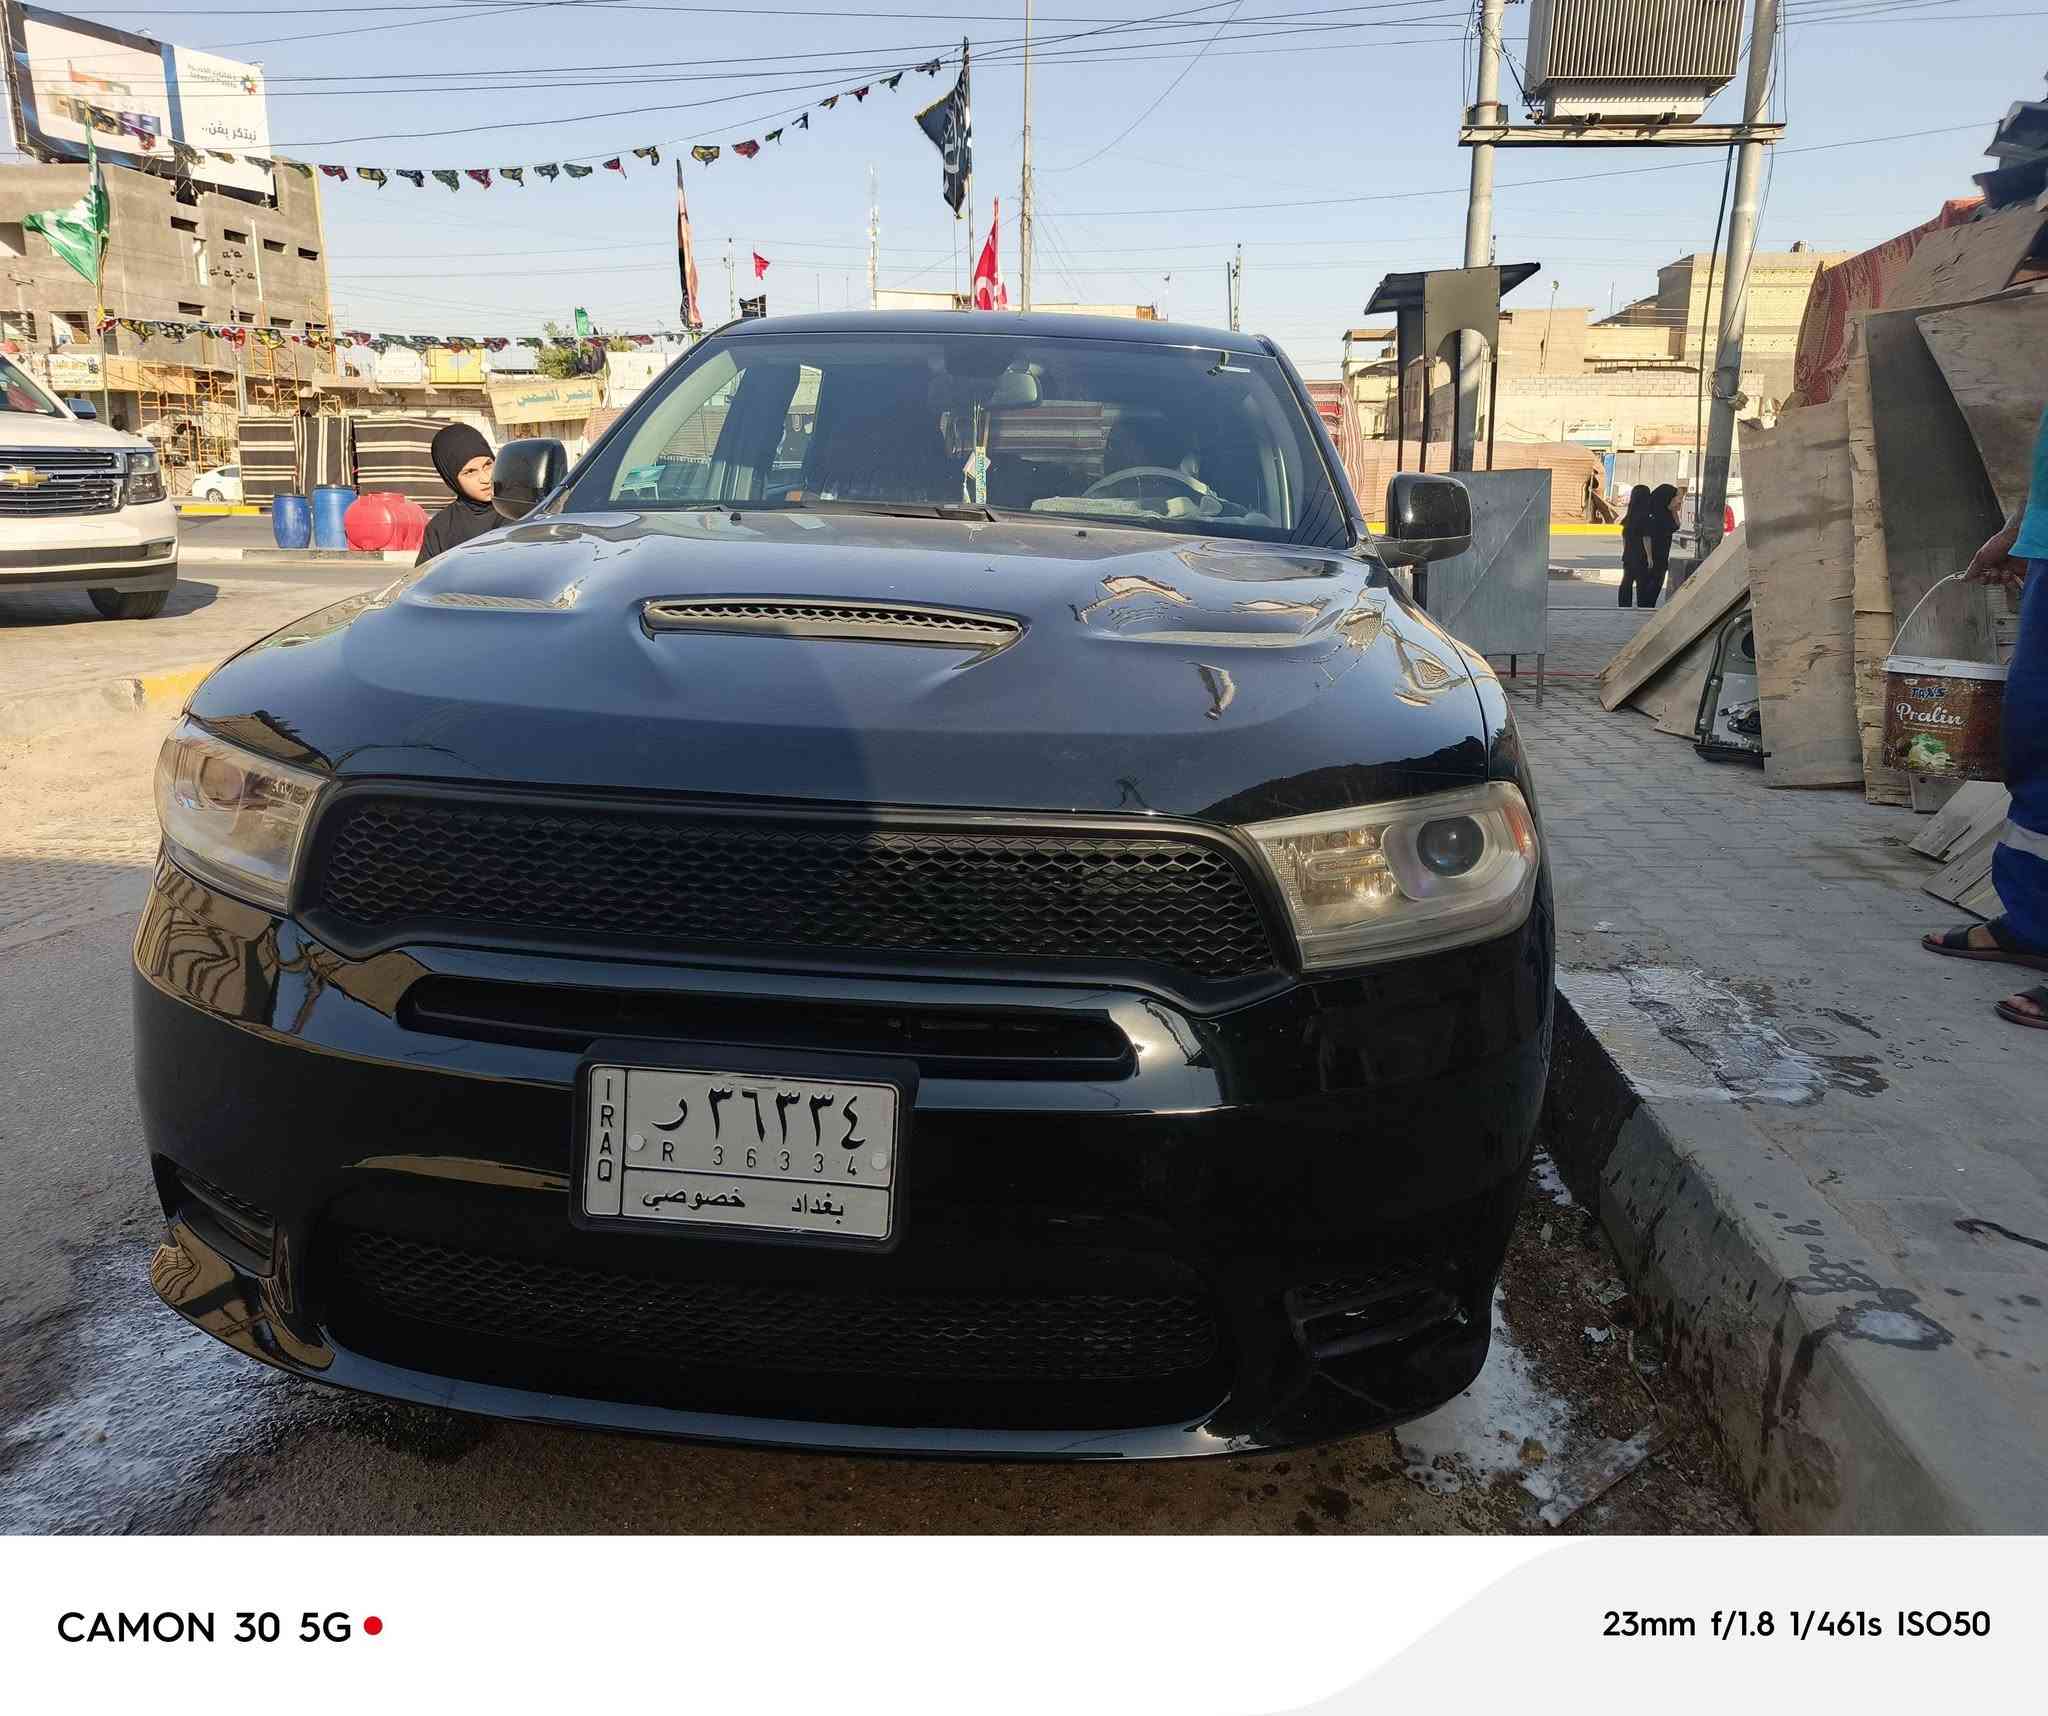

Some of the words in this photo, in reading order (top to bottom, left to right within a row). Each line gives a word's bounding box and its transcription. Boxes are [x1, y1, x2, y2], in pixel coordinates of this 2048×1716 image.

[1895, 702, 1964, 725] Pralin
[598, 1078, 615, 1183] IRAQ
[641, 1187, 746, 1212] خصوصي
[791, 1192, 844, 1225] بغداد
